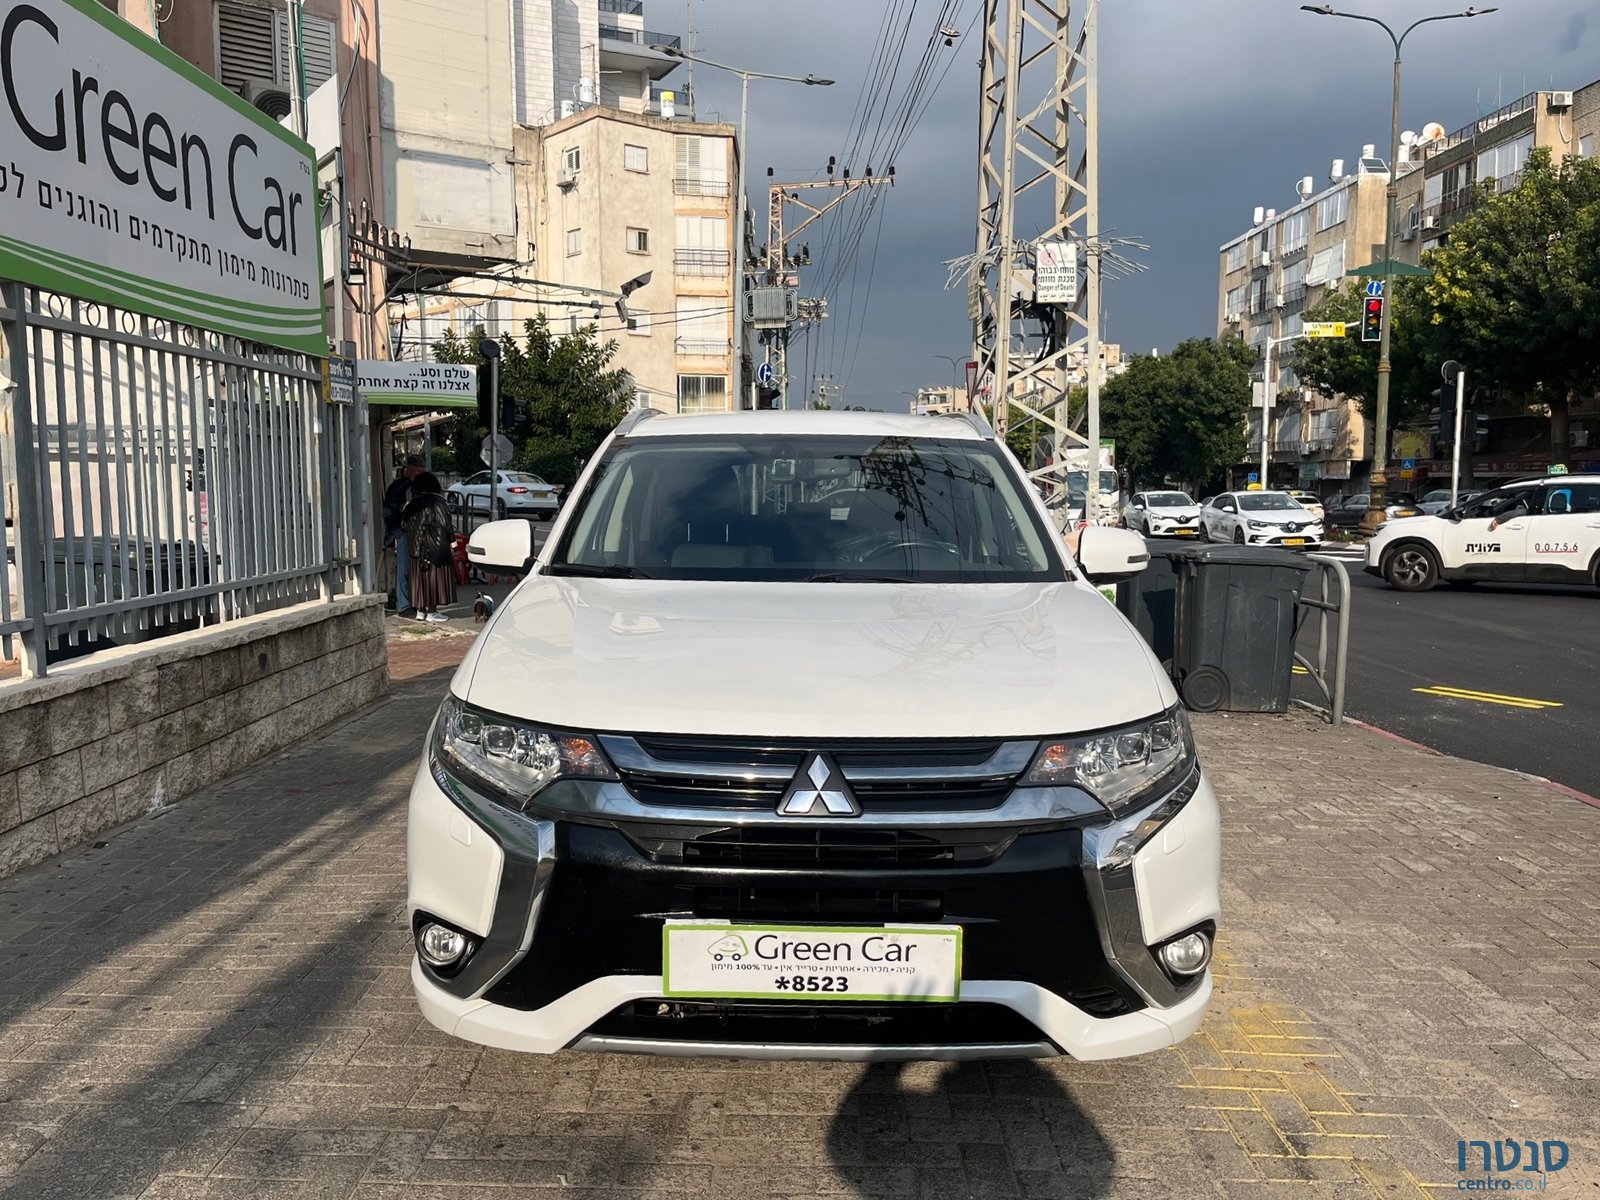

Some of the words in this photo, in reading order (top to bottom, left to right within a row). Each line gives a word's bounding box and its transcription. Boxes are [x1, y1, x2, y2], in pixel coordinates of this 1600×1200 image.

[1, 4, 215, 221] Green
[228, 133, 303, 256] Car
[38, 179, 119, 233] והוגנים
[129, 215, 211, 265] מתקדמים
[218, 249, 256, 281] מימון
[261, 265, 309, 300] פתרונות
[1058, 275, 1075, 283] סכנת
[1038, 284, 1054, 292] Danger
[408, 367, 440, 378] וסע...
[444, 367, 470, 379] שלם
[357, 377, 390, 388] אחרת
[393, 379, 418, 391] קצת
[422, 380, 435, 389] זה
[439, 379, 470, 391] אצלנו
[755, 934, 851, 962] Green
[861, 936, 917, 962] Car
[710, 963, 733, 971] מימון
[735, 963, 761, 971] 100%
[780, 964, 793, 972] אין
[795, 964, 818, 972] טרייד
[825, 965, 856, 973] אחריות
[862, 965, 889, 973] מכירה
[896, 965, 916, 974] קניה
